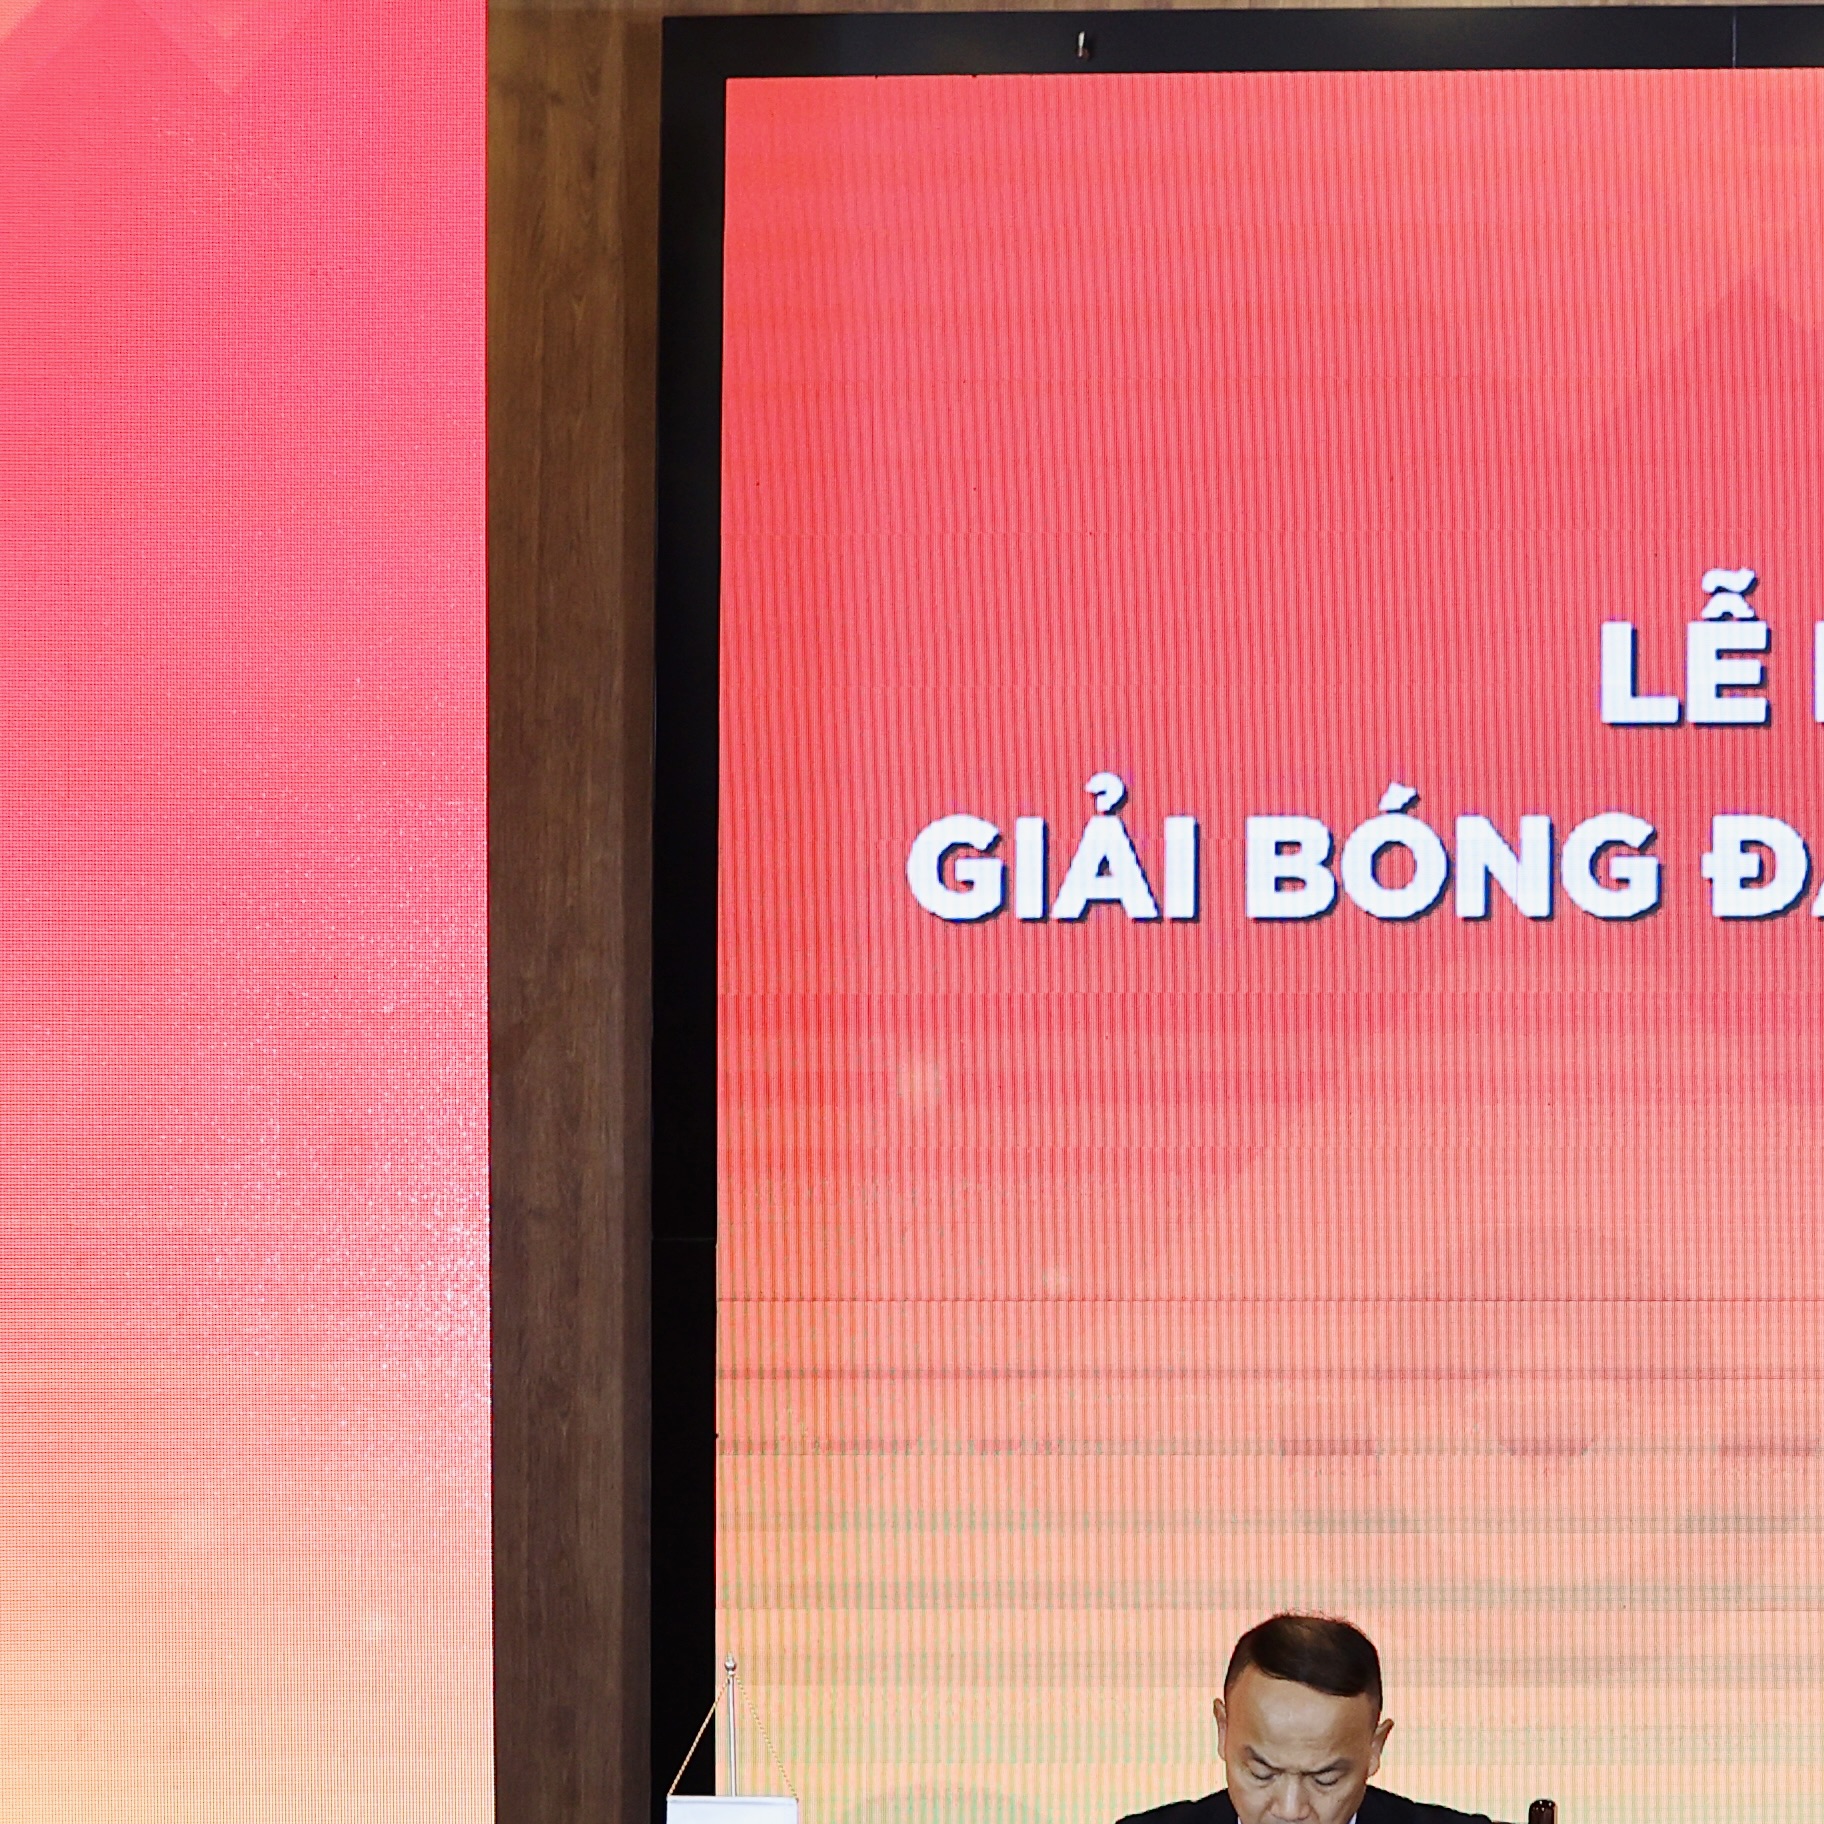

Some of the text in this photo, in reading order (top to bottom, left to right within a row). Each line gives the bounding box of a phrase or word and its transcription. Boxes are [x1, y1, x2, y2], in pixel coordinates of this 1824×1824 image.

[1602, 569, 1770, 725] LỄ
[906, 772, 1197, 921] GIẢI
[1246, 783, 1661, 920] BÓNG
